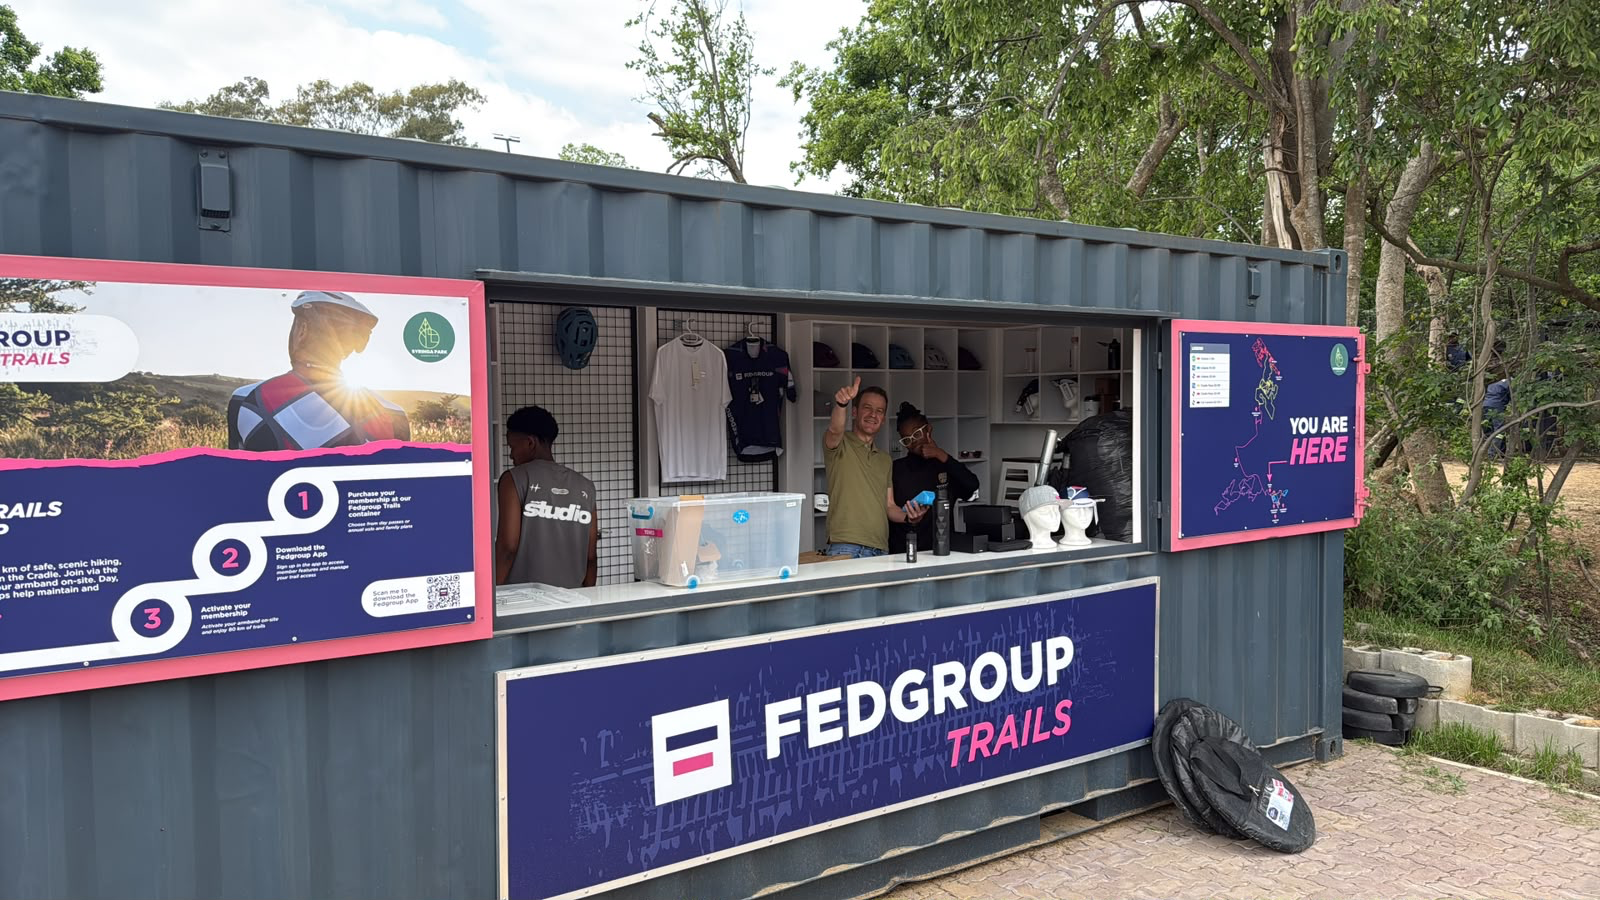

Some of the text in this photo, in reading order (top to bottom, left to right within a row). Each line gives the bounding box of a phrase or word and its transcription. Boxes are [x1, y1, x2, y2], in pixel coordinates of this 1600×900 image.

[0, 352, 71, 366] TRAILS
[1290, 416, 1348, 434] YOU ARE
[1289, 436, 1348, 465] HERE
[298, 491, 308, 511] 1
[348, 496, 390, 504] membership
[276, 545, 312, 553] Download
[276, 552, 311, 560] Fedgroup
[222, 547, 239, 568] 2
[20, 564, 31, 572] of
[33, 563, 56, 571] safe,
[58, 560, 88, 569] scenic
[8, 574, 24, 582] the
[27, 571, 61, 580] Cradle.
[64, 569, 84, 577] Join
[86, 567, 100, 575] via
[103, 566, 118, 574] the
[14, 579, 58, 590] armband
[61, 577, 96, 586] on-site.
[98, 575, 119, 583] Day,
[13, 590, 34, 599] help
[37, 586, 79, 596] maintain
[81, 584, 99, 592] and
[373, 594, 404, 602] download
[201, 605, 232, 613] Activate
[201, 610, 248, 620] membership
[144, 608, 161, 629] 3
[765, 635, 1074, 760] FEDGROUP
[947, 699, 1073, 767] TRAILS
